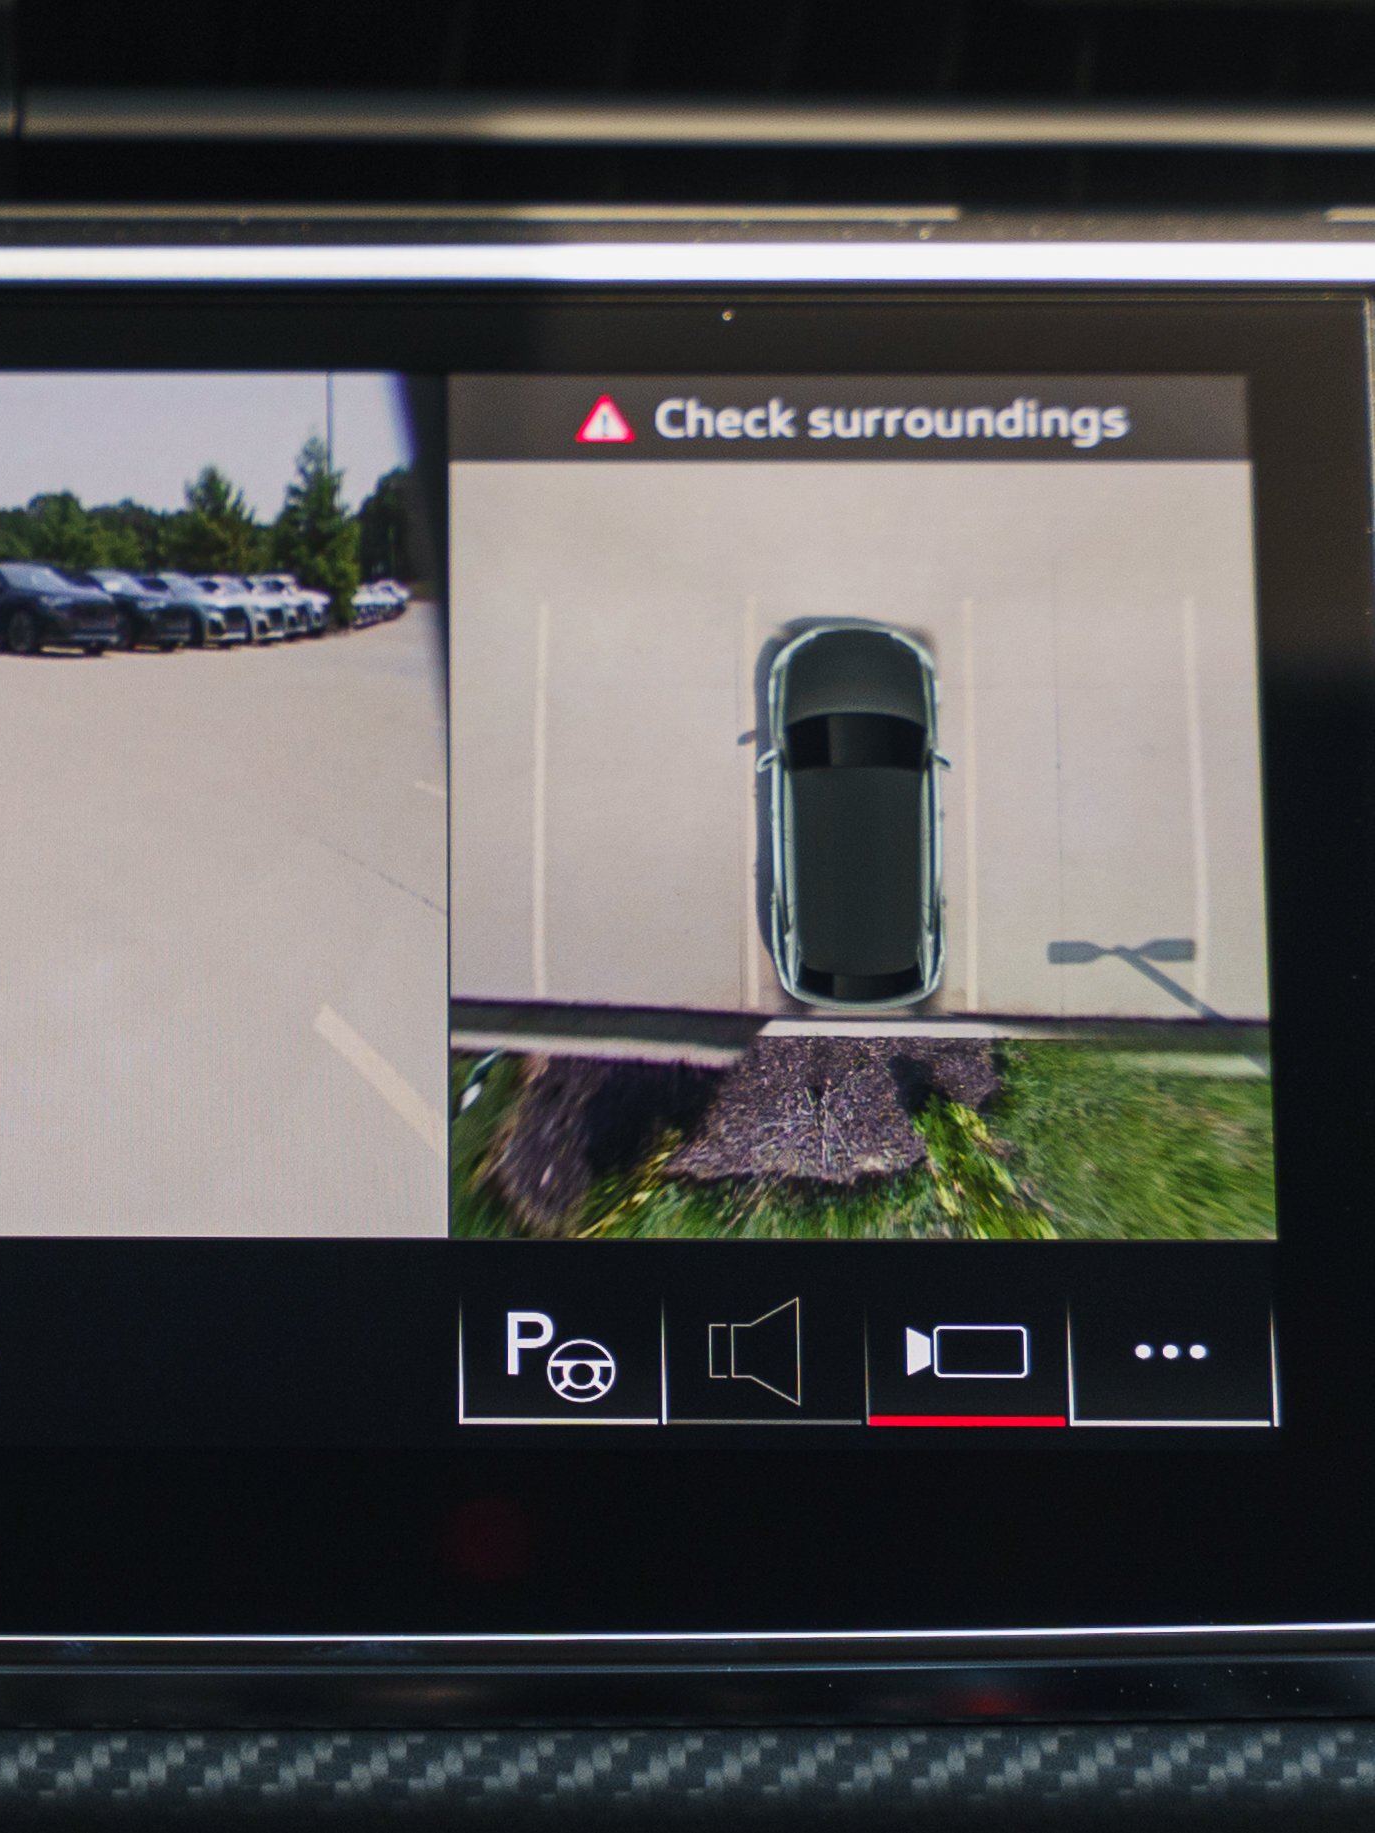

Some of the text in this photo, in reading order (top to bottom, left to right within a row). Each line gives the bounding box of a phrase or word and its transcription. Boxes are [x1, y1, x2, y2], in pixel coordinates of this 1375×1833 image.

[654, 398, 1129, 449] Check surroundings
[506, 1310, 554, 1376] P
